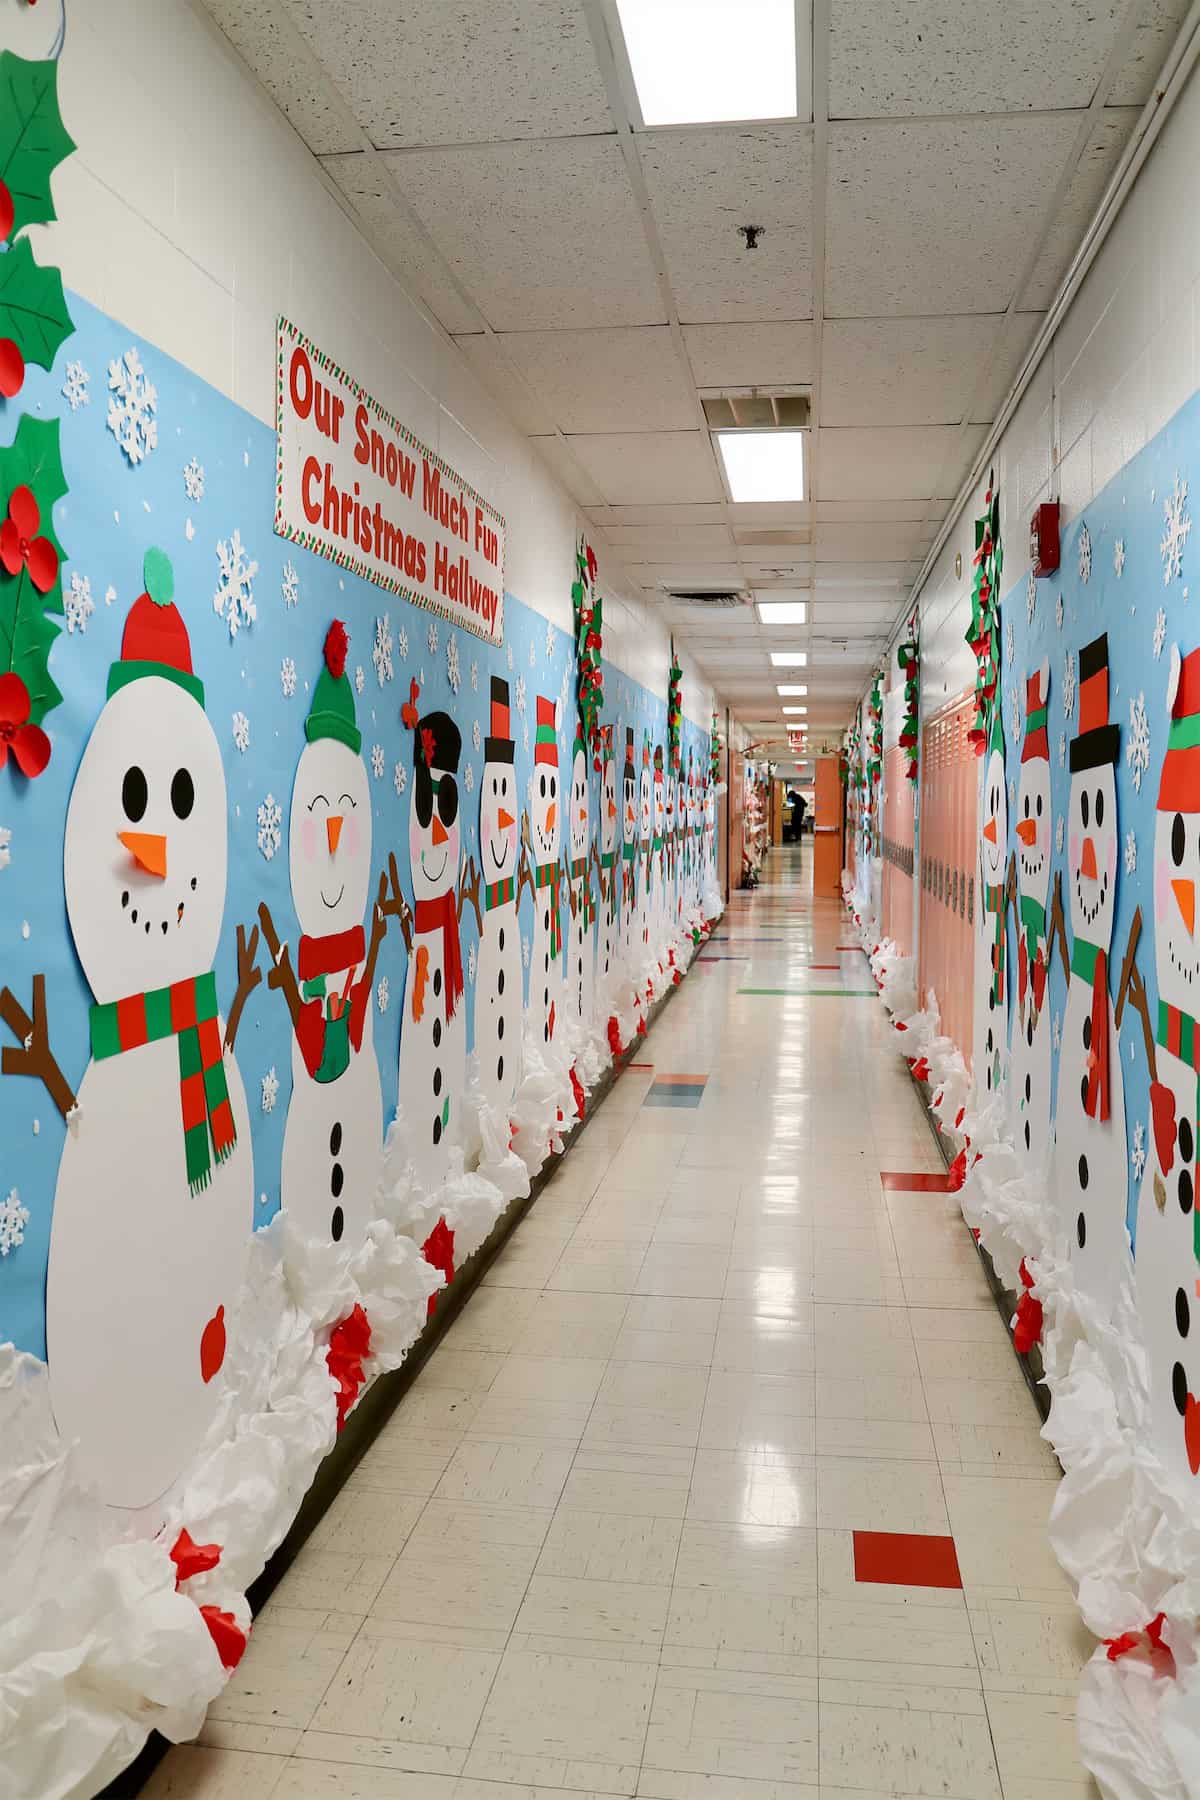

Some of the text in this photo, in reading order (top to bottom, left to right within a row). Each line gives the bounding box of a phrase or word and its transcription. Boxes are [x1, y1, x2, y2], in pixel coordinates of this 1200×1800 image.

[289, 346, 498, 567] Our Snow Much Fun
[301, 456, 498, 637] Christmas Hallway
